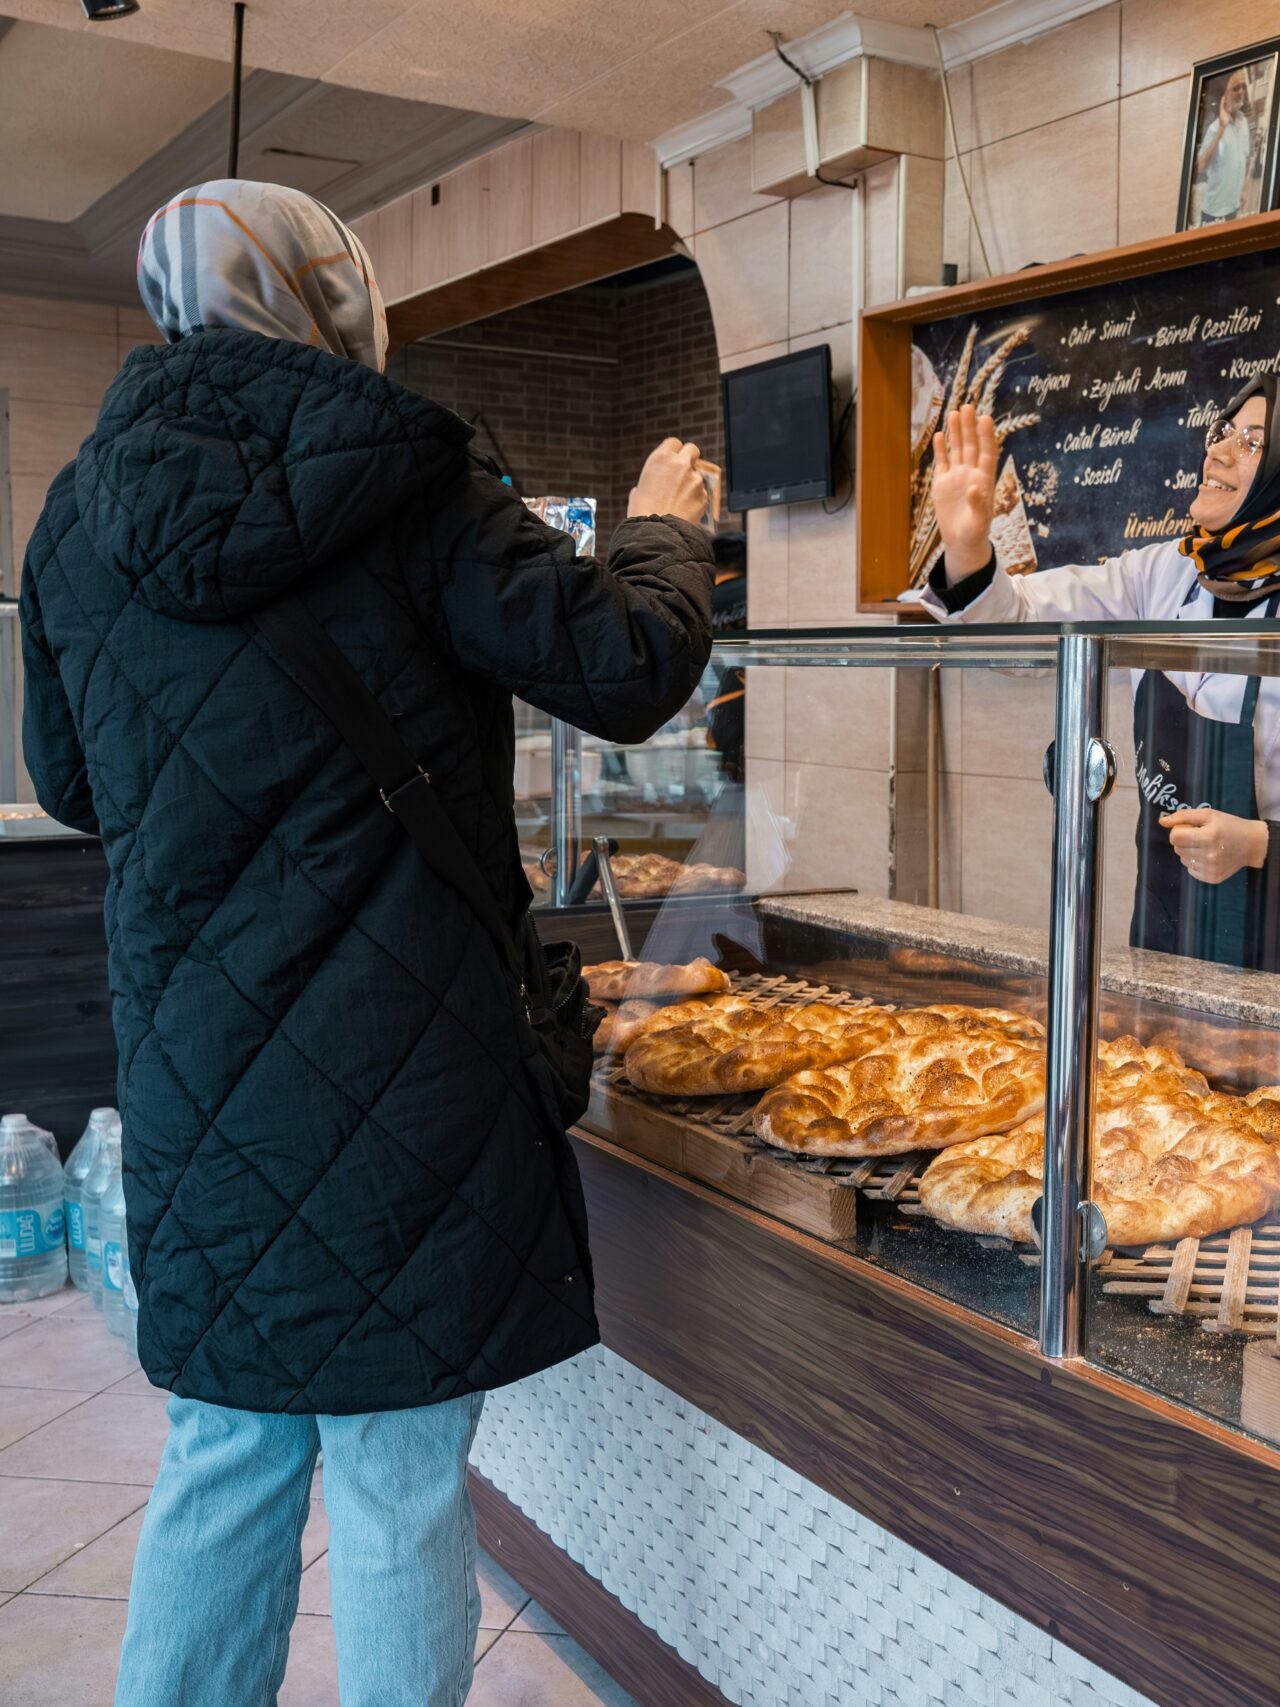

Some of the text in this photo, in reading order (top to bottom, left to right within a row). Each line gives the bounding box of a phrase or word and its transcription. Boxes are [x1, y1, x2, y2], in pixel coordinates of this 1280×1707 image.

[1099, 310, 1136, 341] Simit
[1155, 315, 1201, 347] Börek
[1099, 417, 1143, 448] Börek
[1080, 458, 1122, 486] Sosisli
